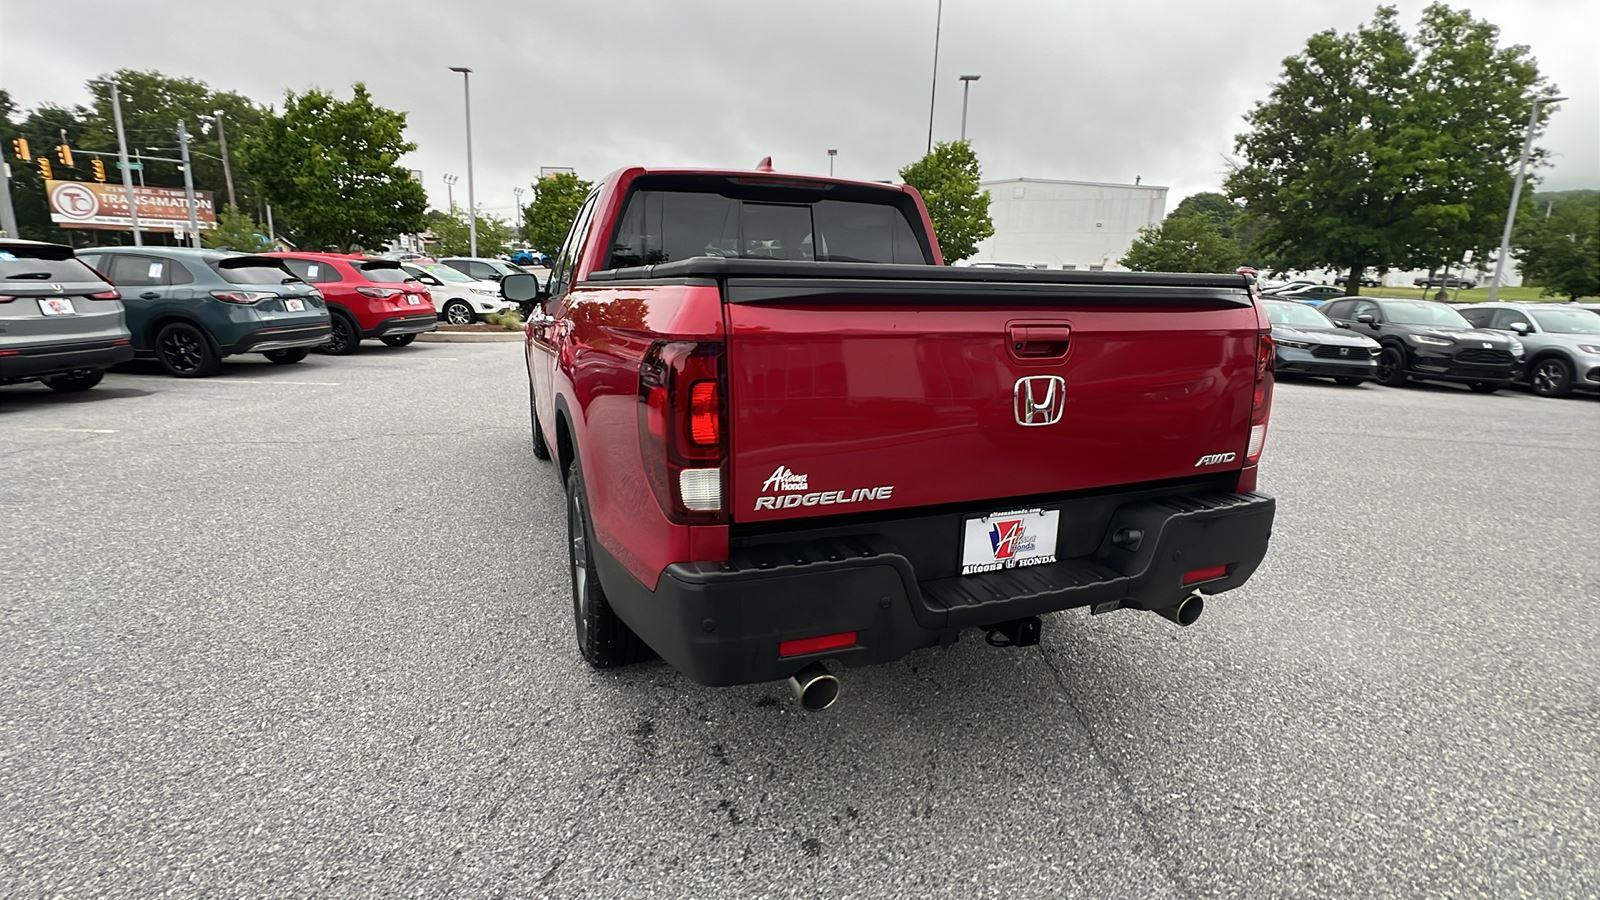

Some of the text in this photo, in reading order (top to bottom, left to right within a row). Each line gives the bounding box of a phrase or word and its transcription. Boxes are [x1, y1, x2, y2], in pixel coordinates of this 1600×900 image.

[1194, 451, 1236, 467] AWD
[781, 482, 808, 490] Honda
[754, 486, 894, 510] RIDGELINE
[962, 563, 1003, 575] Altoona
[1019, 555, 1056, 567] HONDA
